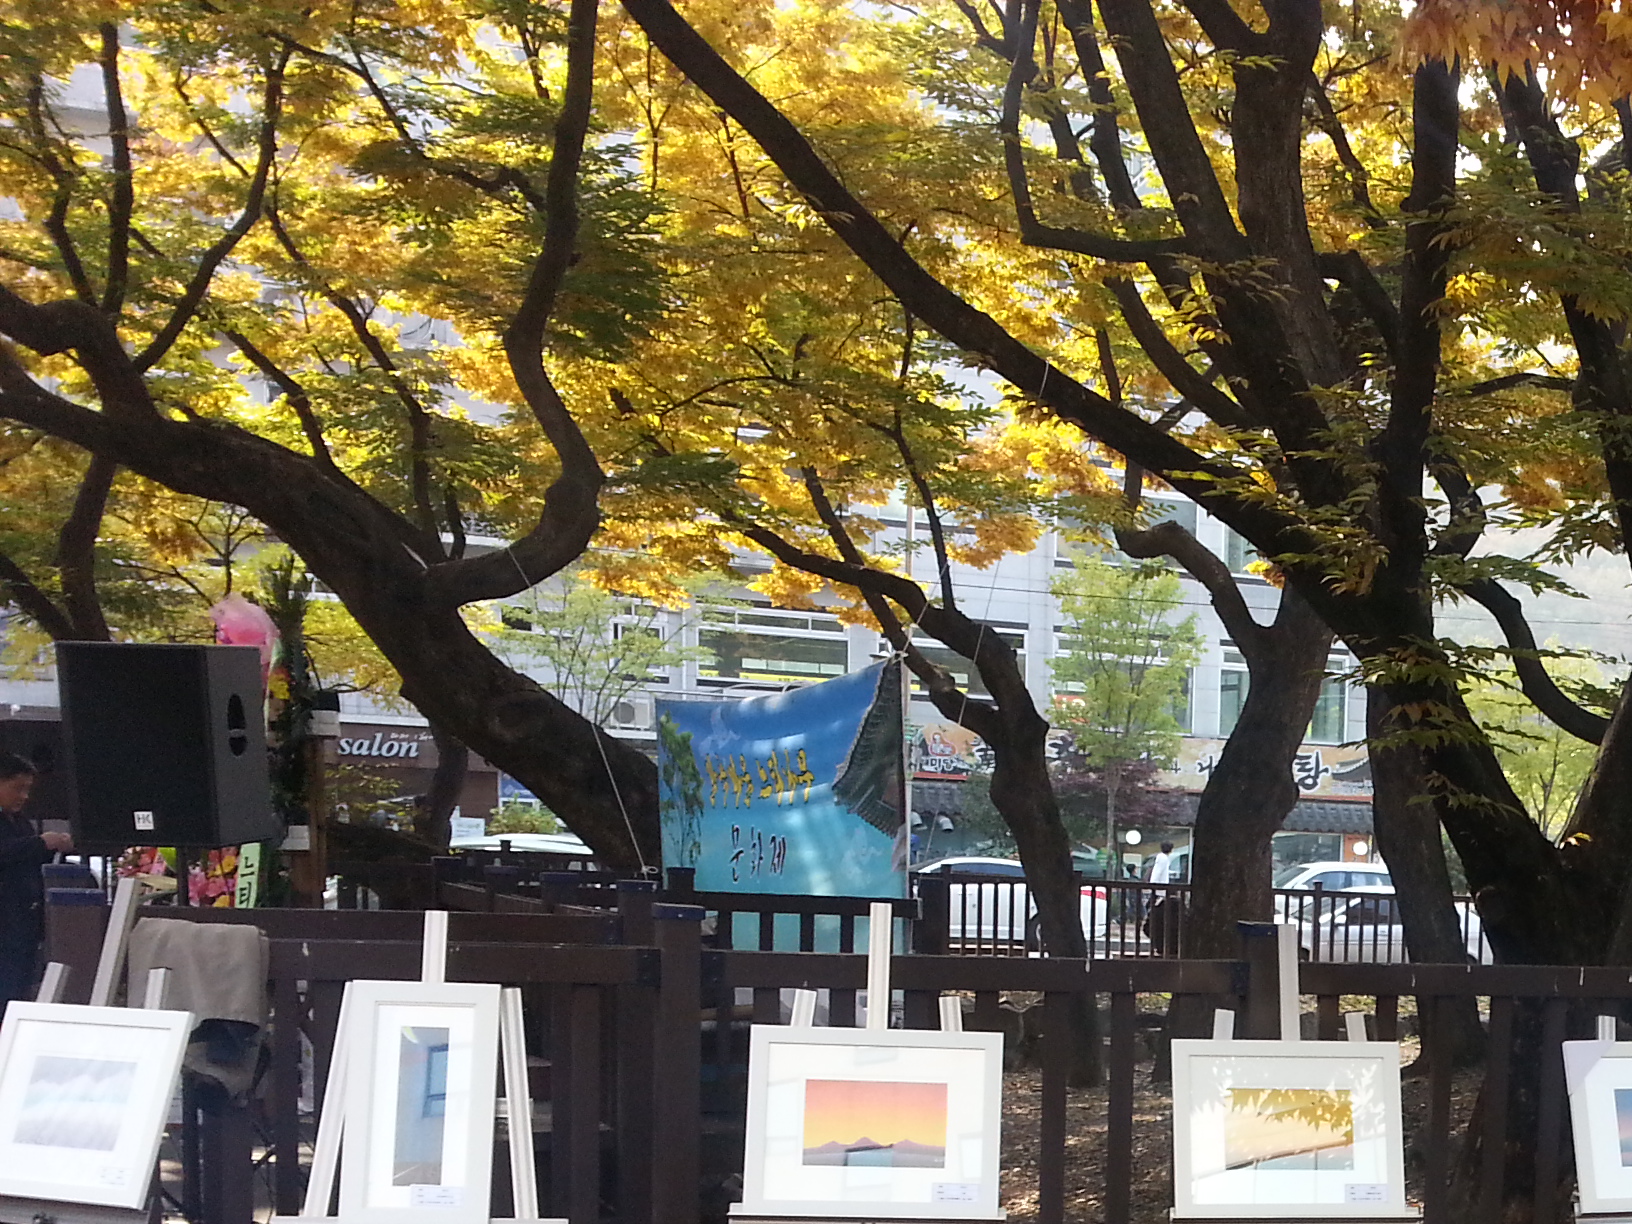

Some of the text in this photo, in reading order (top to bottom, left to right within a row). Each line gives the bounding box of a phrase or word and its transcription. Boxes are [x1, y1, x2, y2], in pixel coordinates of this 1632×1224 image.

[337, 733, 419, 758] salon
[929, 757, 954, 771] 미당
[1295, 751, 1329, 791] 탕
